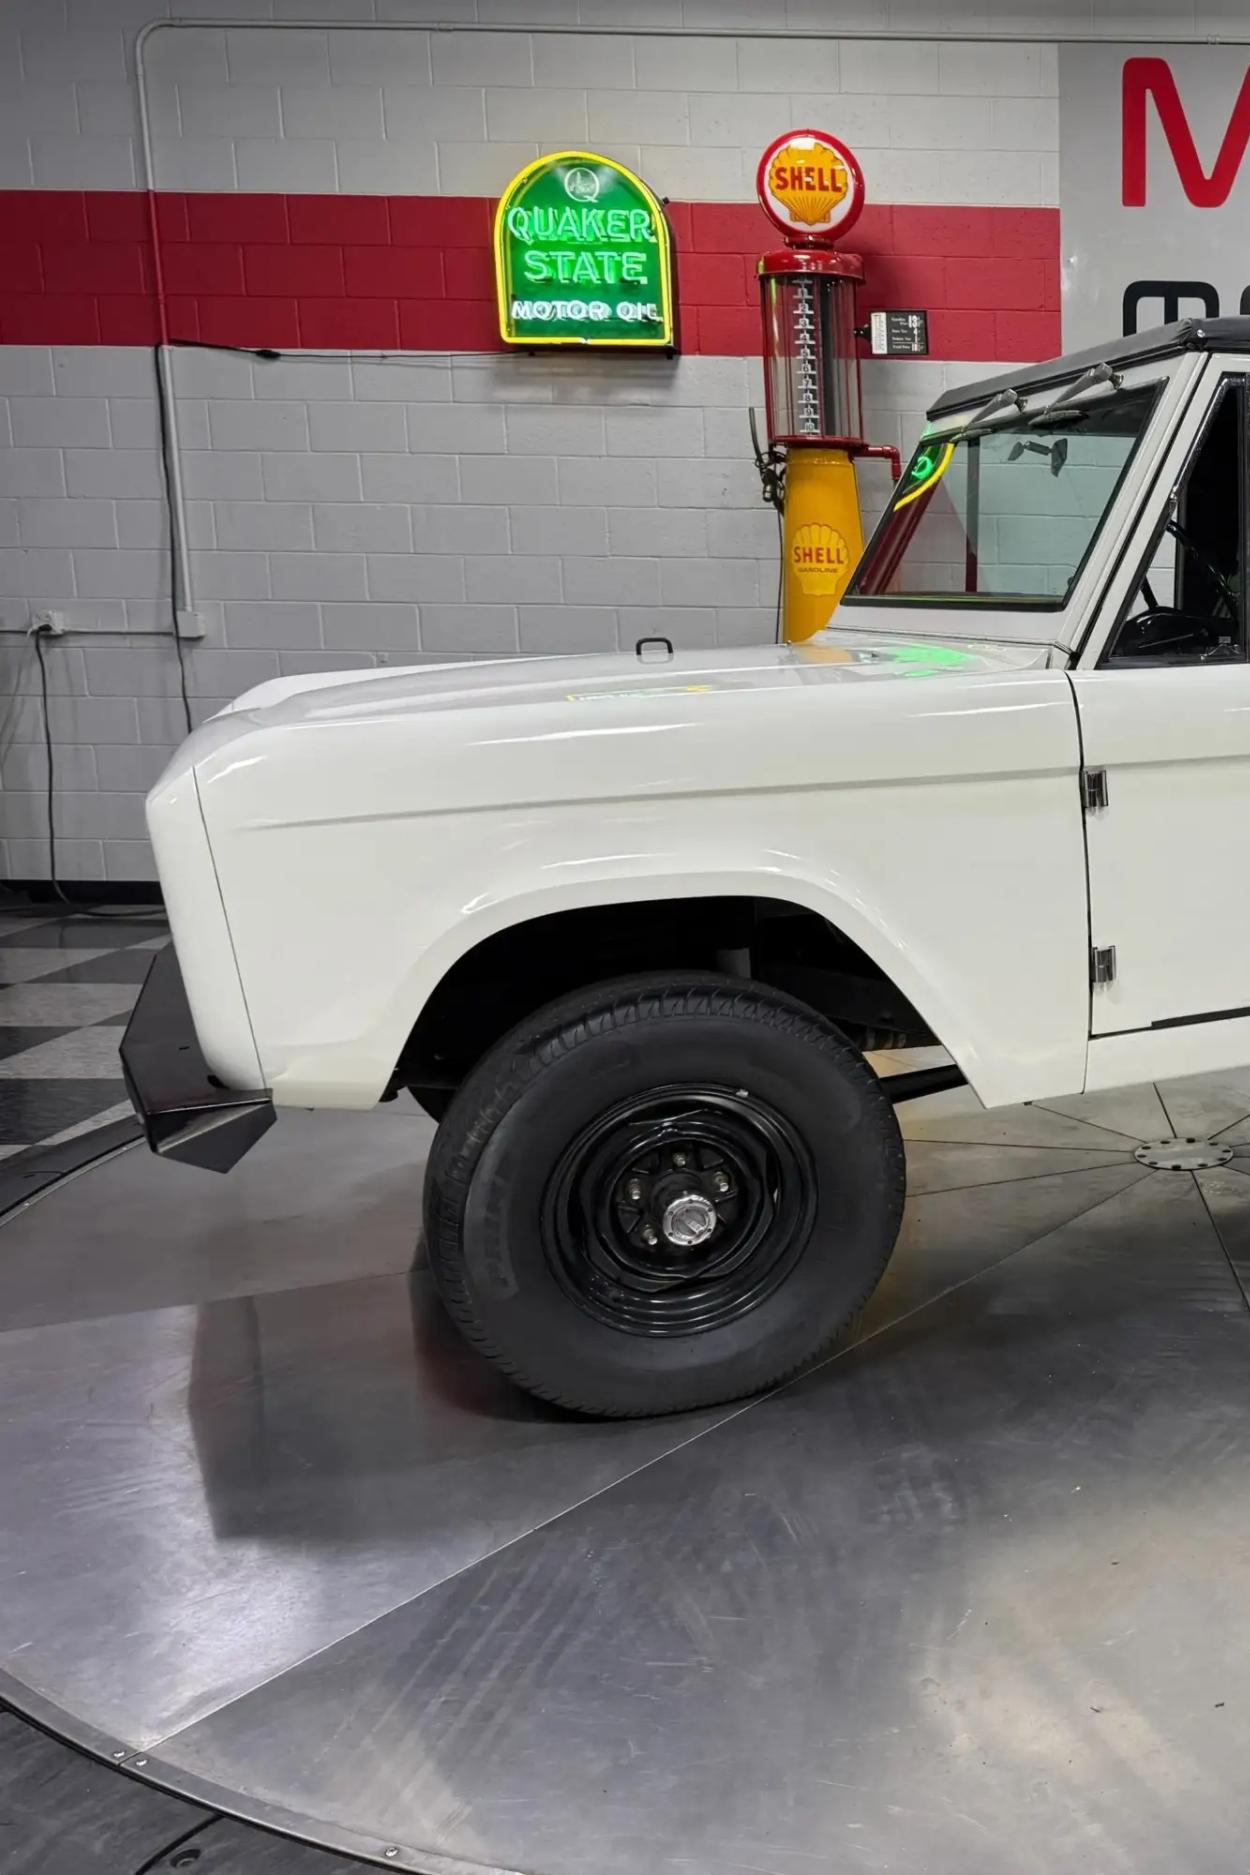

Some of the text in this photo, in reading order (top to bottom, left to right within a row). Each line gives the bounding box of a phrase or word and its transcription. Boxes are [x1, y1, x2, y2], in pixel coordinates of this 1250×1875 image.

[775, 166, 843, 193] SHELL
[507, 206, 658, 245] QUAKER
[523, 250, 648, 285] STATE
[511, 300, 664, 322] MOTOR OIL
[793, 546, 845, 565] SHELL
